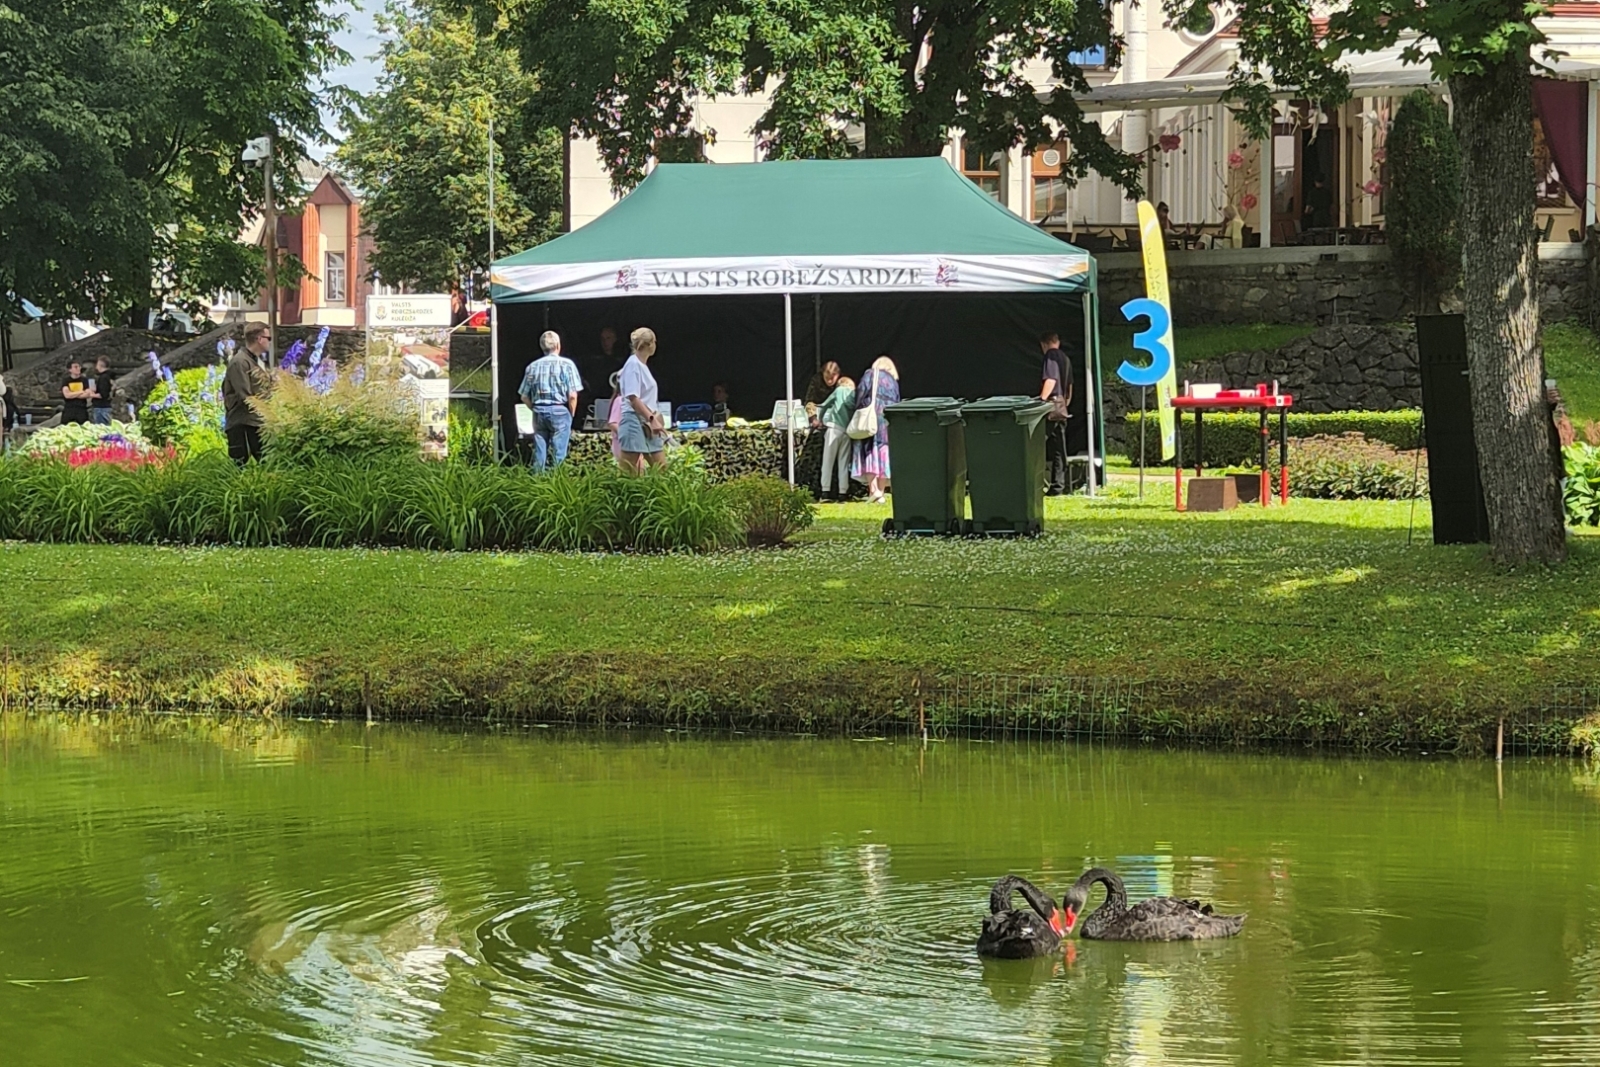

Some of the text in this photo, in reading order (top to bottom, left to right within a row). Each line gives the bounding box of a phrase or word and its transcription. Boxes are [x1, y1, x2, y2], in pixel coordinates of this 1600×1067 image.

[652, 265, 922, 287] VALSTS ROBEŽSARDZE
[1117, 298, 1171, 385] 3
